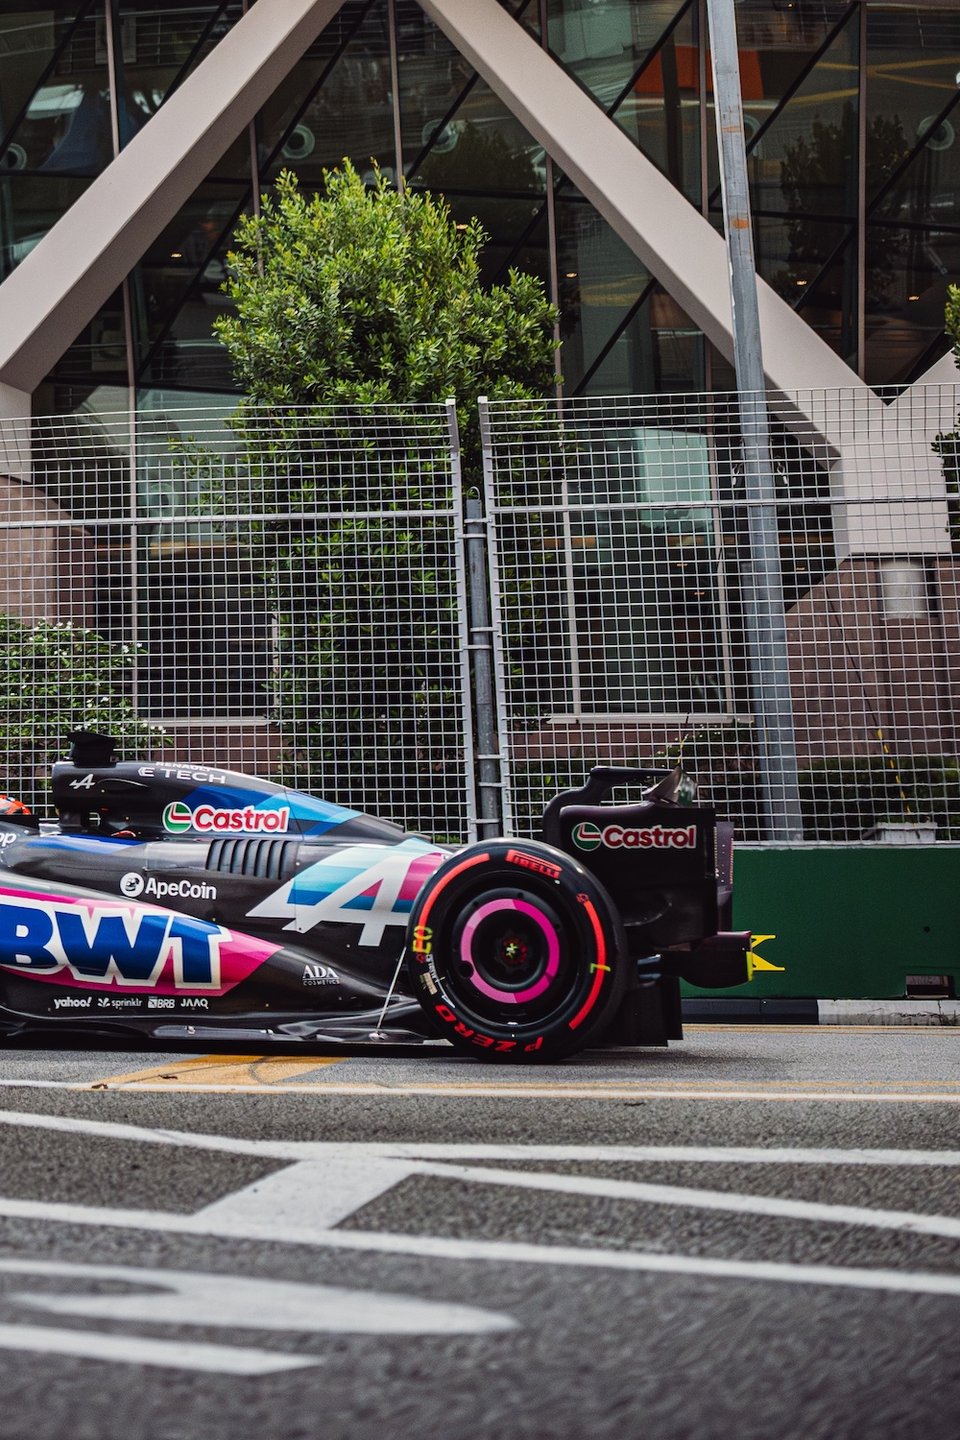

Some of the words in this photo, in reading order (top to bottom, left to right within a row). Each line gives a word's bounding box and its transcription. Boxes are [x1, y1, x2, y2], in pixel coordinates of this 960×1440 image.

[160, 768, 226, 784] TECH
[193, 806, 289, 832] Castrol
[603, 825, 696, 848] Castrol
[506, 849, 563, 879] PIRELLI
[145, 878, 217, 900] ApeCoin
[302, 964, 339, 978] ADA
[54, 996, 92, 1009] yahoo!
[111, 997, 143, 1009] sprinklr
[435, 1005, 517, 1052] ZERO
[524, 1036, 543, 1052] P
